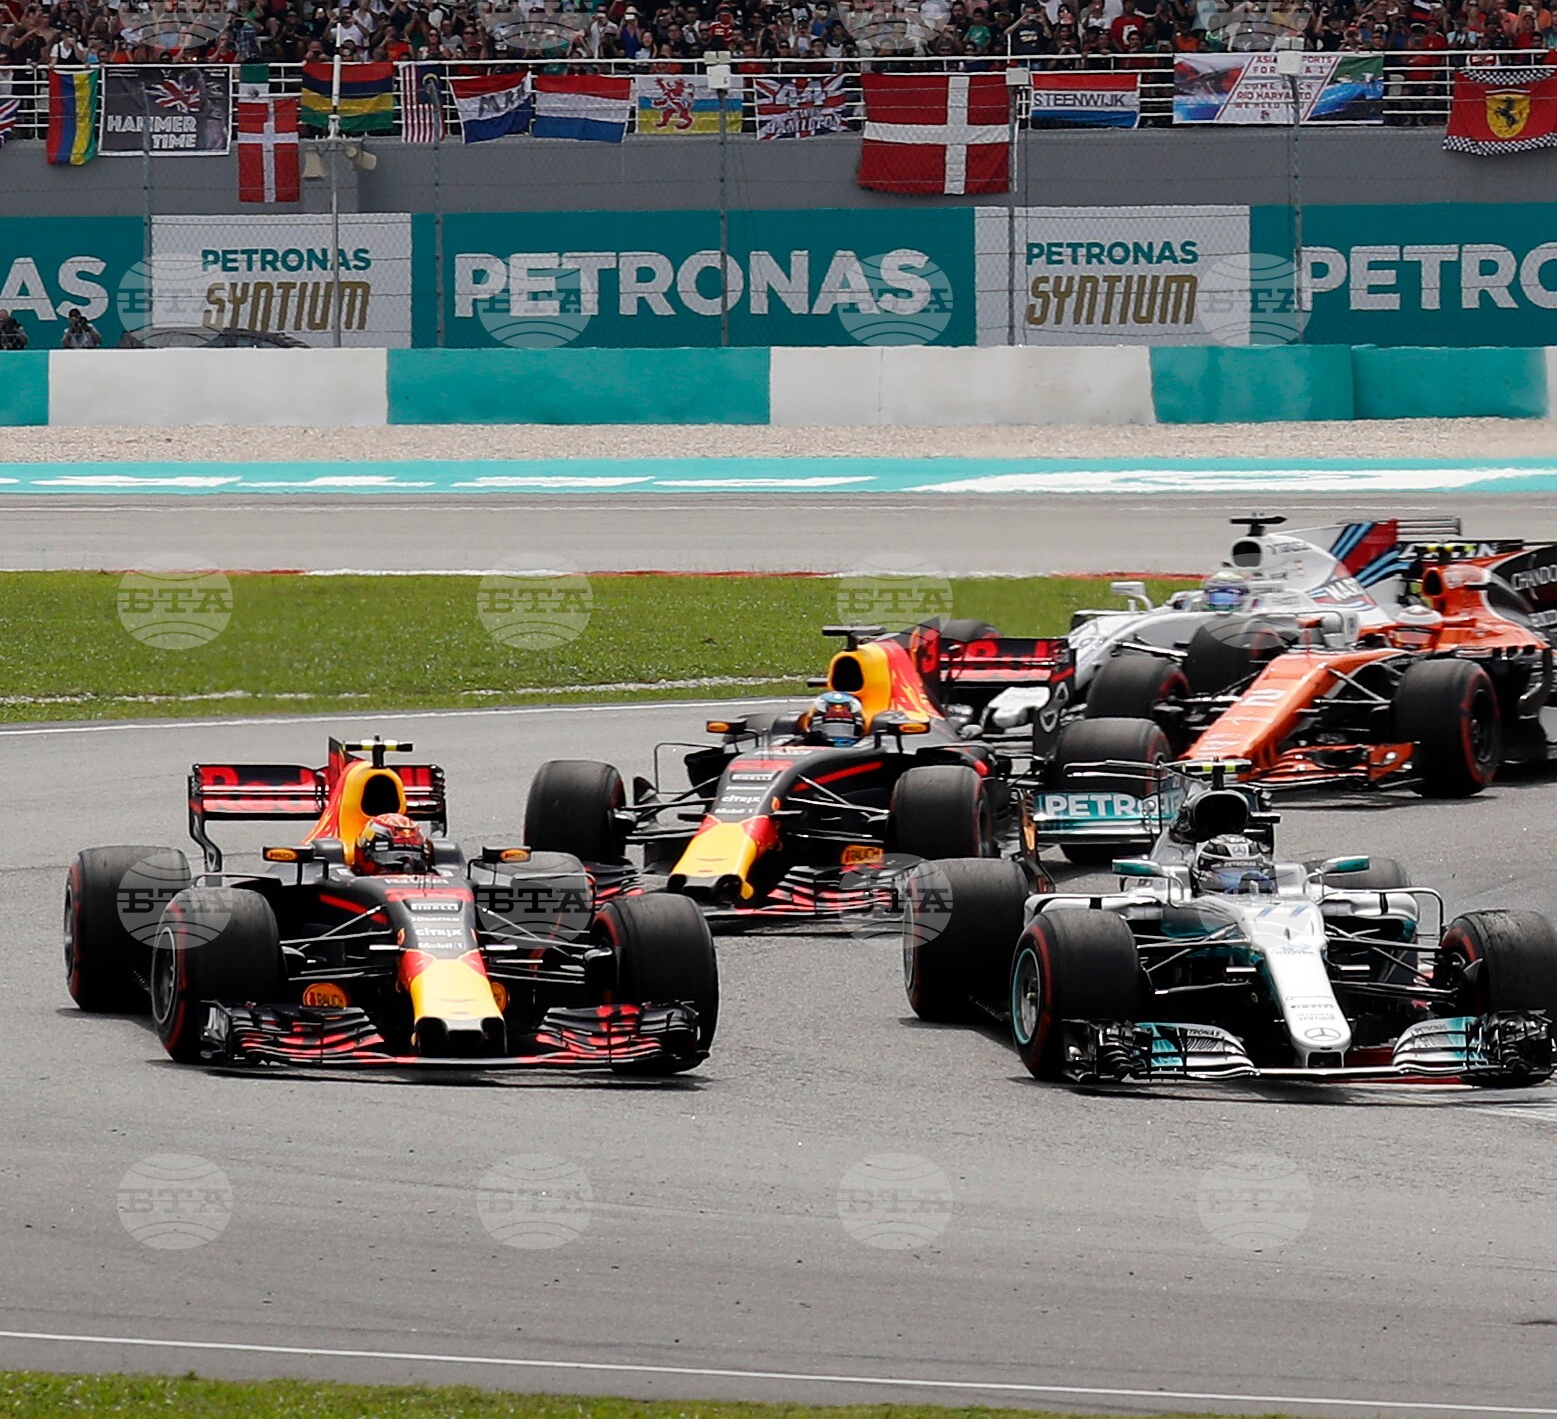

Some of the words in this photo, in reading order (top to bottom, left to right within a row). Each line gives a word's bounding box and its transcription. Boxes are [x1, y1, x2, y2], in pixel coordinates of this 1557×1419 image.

[1033, 93, 1126, 107] STEENWIJK
[1256, 91, 1312, 100] HARYATO
[151, 134, 197, 149] TIME
[202, 247, 371, 272] PETRONAS
[1026, 240, 1199, 265] PETRONAS
[455, 249, 931, 318] PETRONAS
[203, 281, 371, 331] SYNTIUM
[1026, 274, 1198, 326] SYNTIUM
